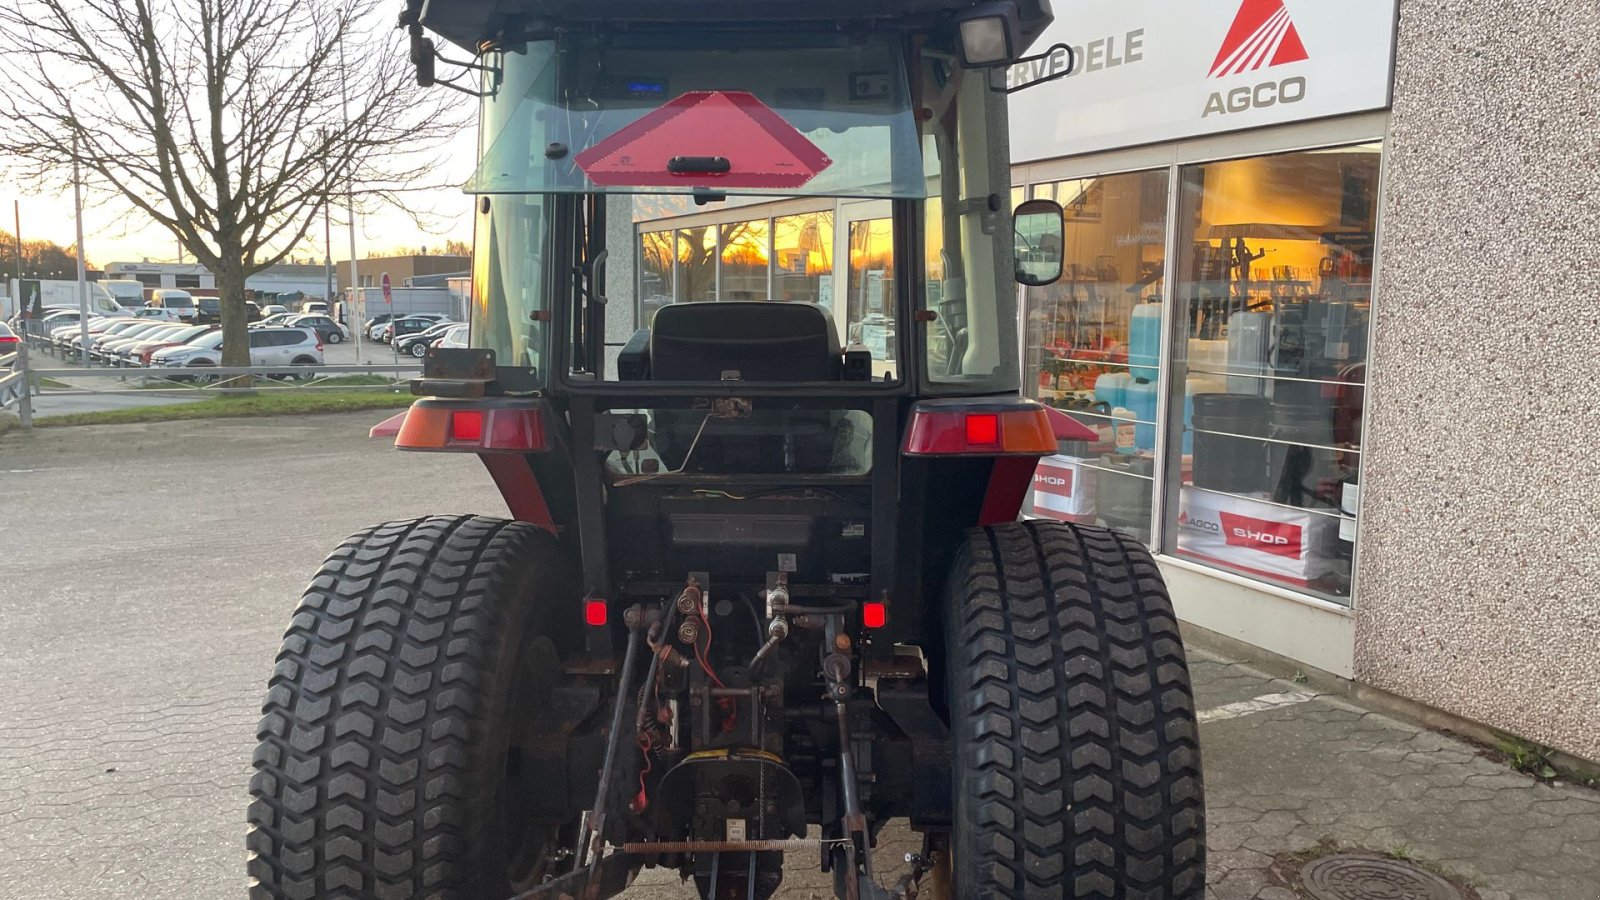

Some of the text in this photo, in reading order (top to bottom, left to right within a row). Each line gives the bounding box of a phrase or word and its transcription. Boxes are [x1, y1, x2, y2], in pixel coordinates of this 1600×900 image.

[1201, 76, 1306, 118] AGCO
[1189, 518, 1219, 531] AGCO
[1233, 527, 1288, 545] SHOP
